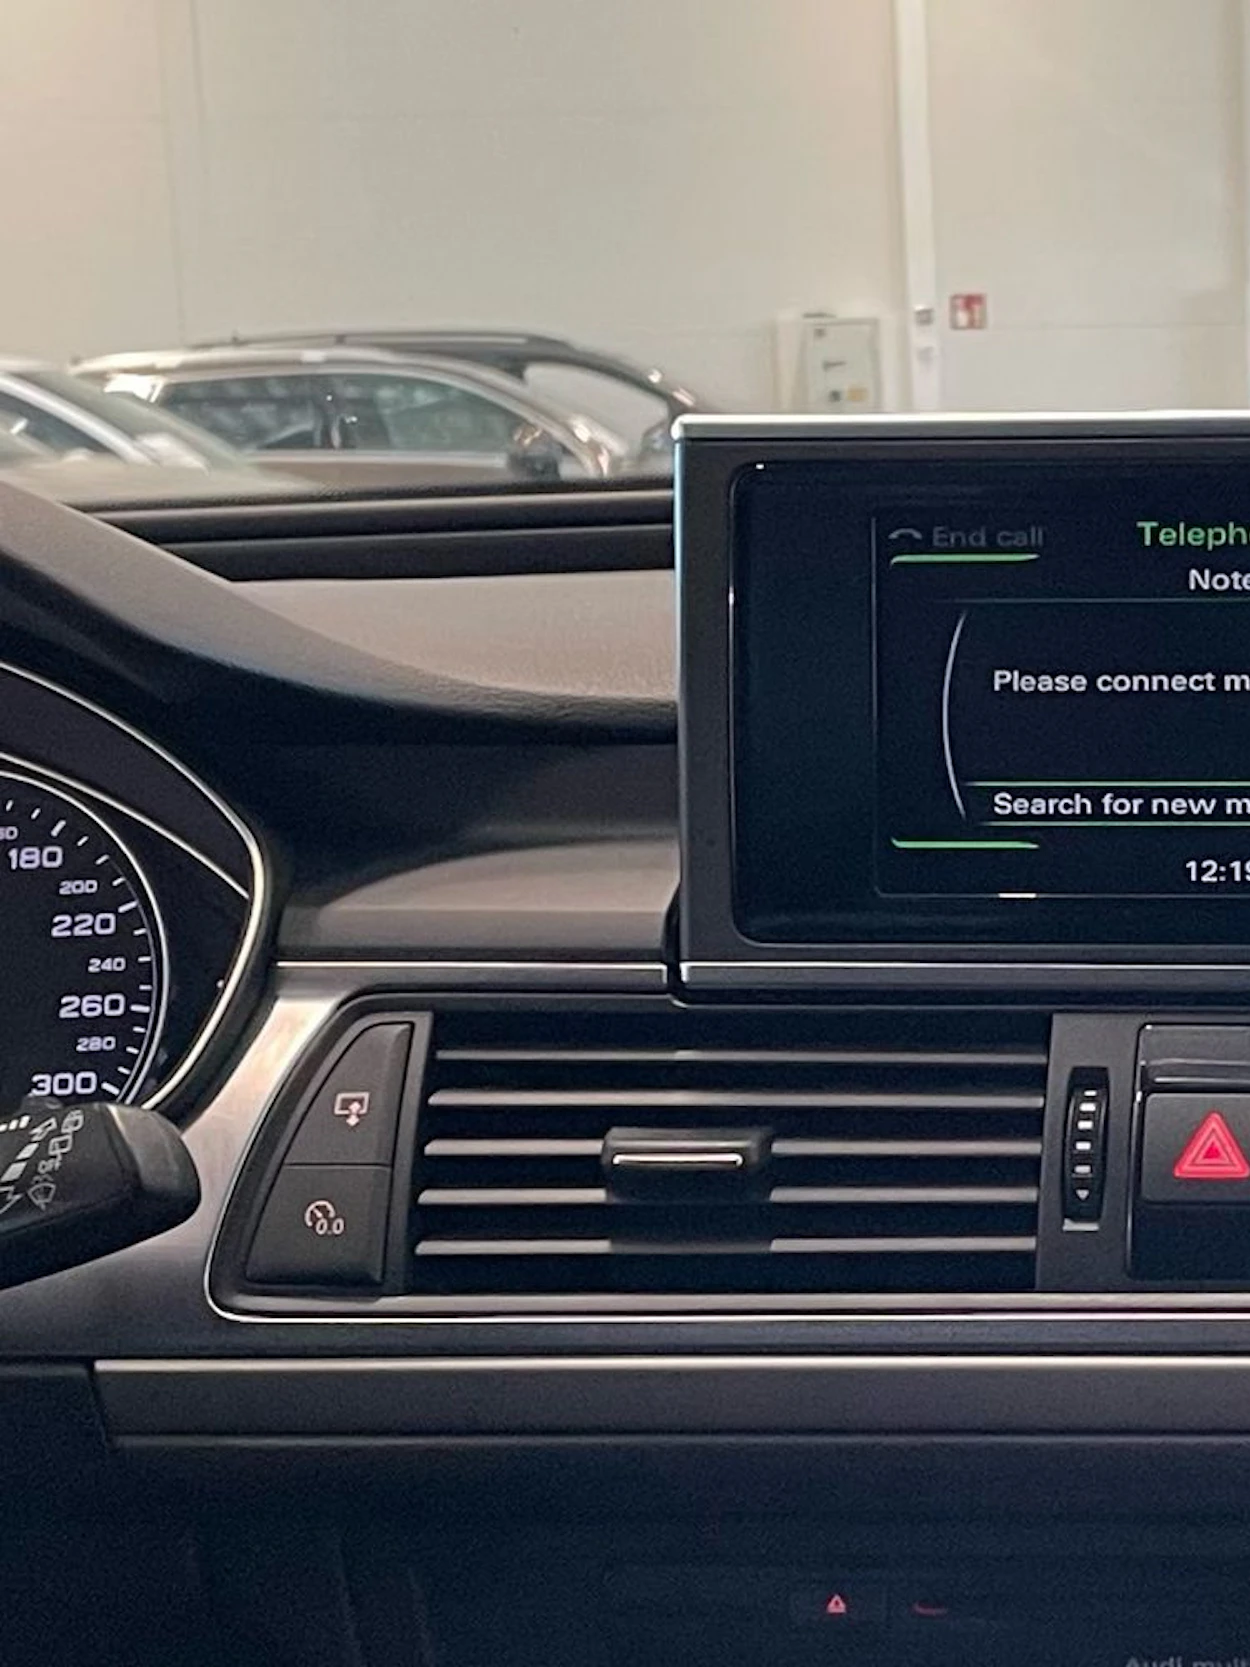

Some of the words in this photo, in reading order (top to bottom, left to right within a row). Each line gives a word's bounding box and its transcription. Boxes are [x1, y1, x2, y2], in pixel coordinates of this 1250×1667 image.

[932, 526, 987, 548] End
[996, 525, 1043, 548] call
[993, 669, 1088, 693] Please
[1096, 672, 1216, 693] connect
[993, 792, 1093, 818] Search
[1102, 792, 1145, 818] for
[1151, 797, 1217, 817] new
[8, 846, 63, 869] 180
[58, 879, 98, 895] 200
[51, 912, 117, 937] 220
[88, 956, 126, 973] 240
[59, 993, 125, 1019] 260
[76, 1035, 116, 1052] 280
[31, 1071, 98, 1097] 300
